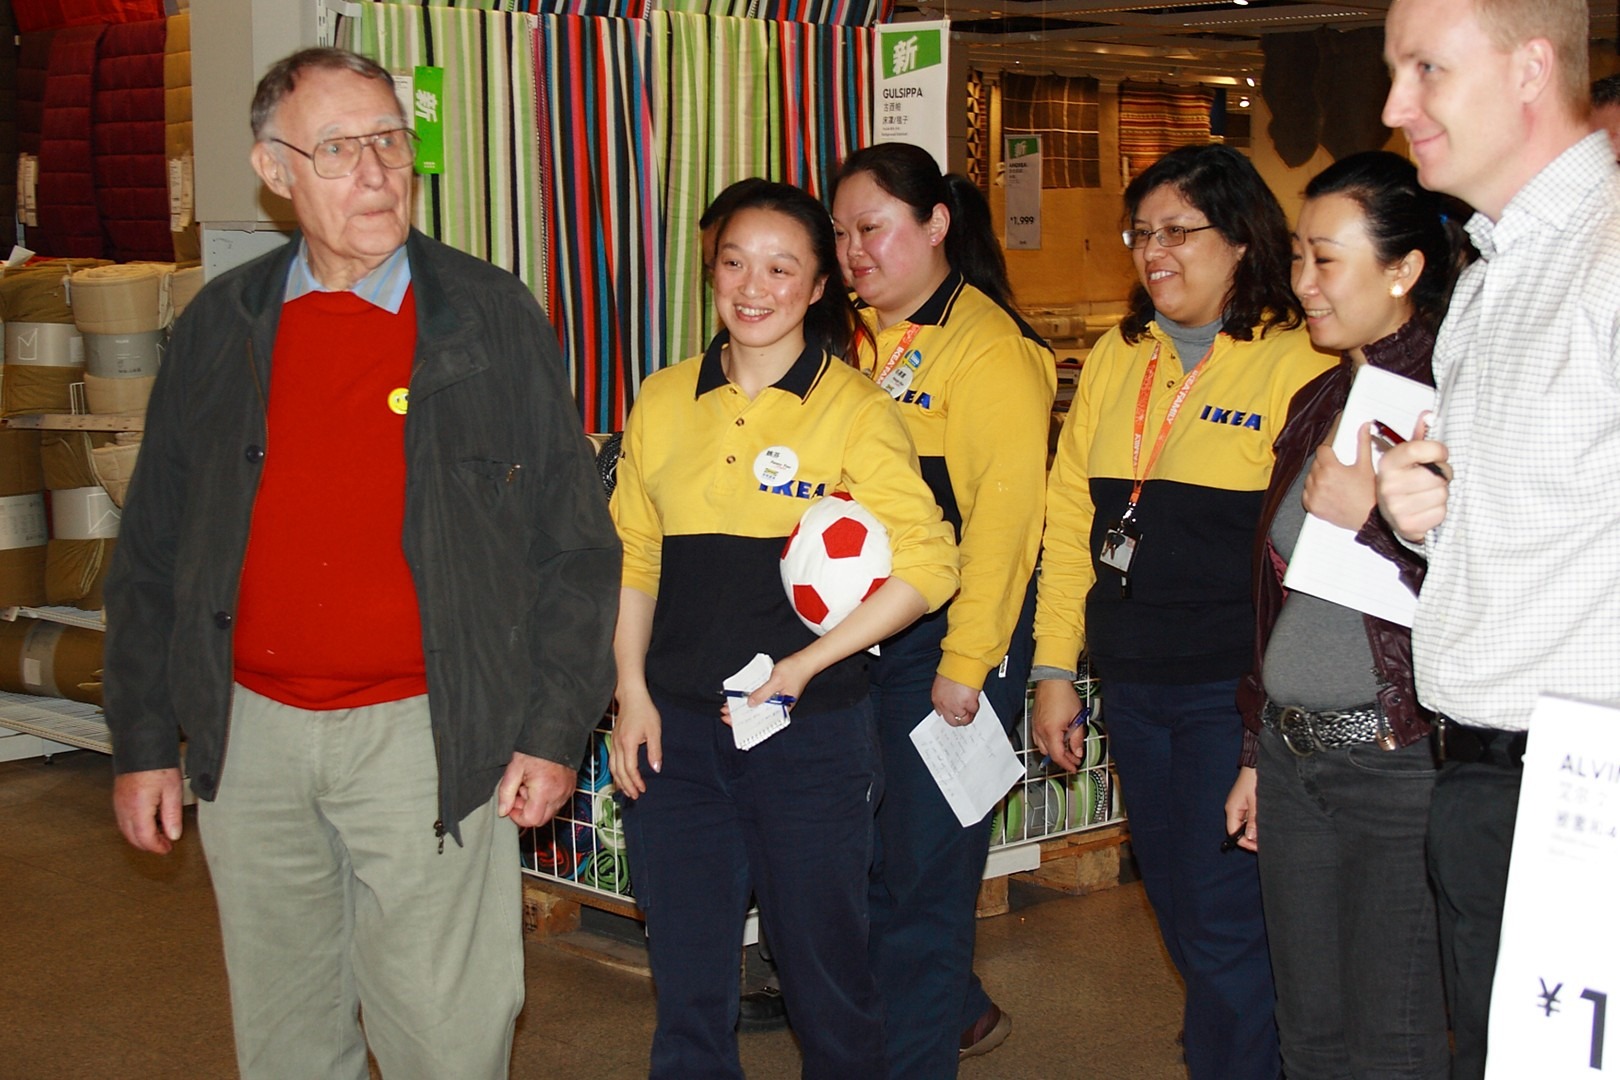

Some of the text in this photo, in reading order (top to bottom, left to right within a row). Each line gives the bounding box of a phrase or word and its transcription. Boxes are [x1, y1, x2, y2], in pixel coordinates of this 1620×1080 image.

[892, 35, 918, 75] 新
[883, 87, 923, 99] GULSIPPA
[1200, 405, 1262, 431] IKEA
